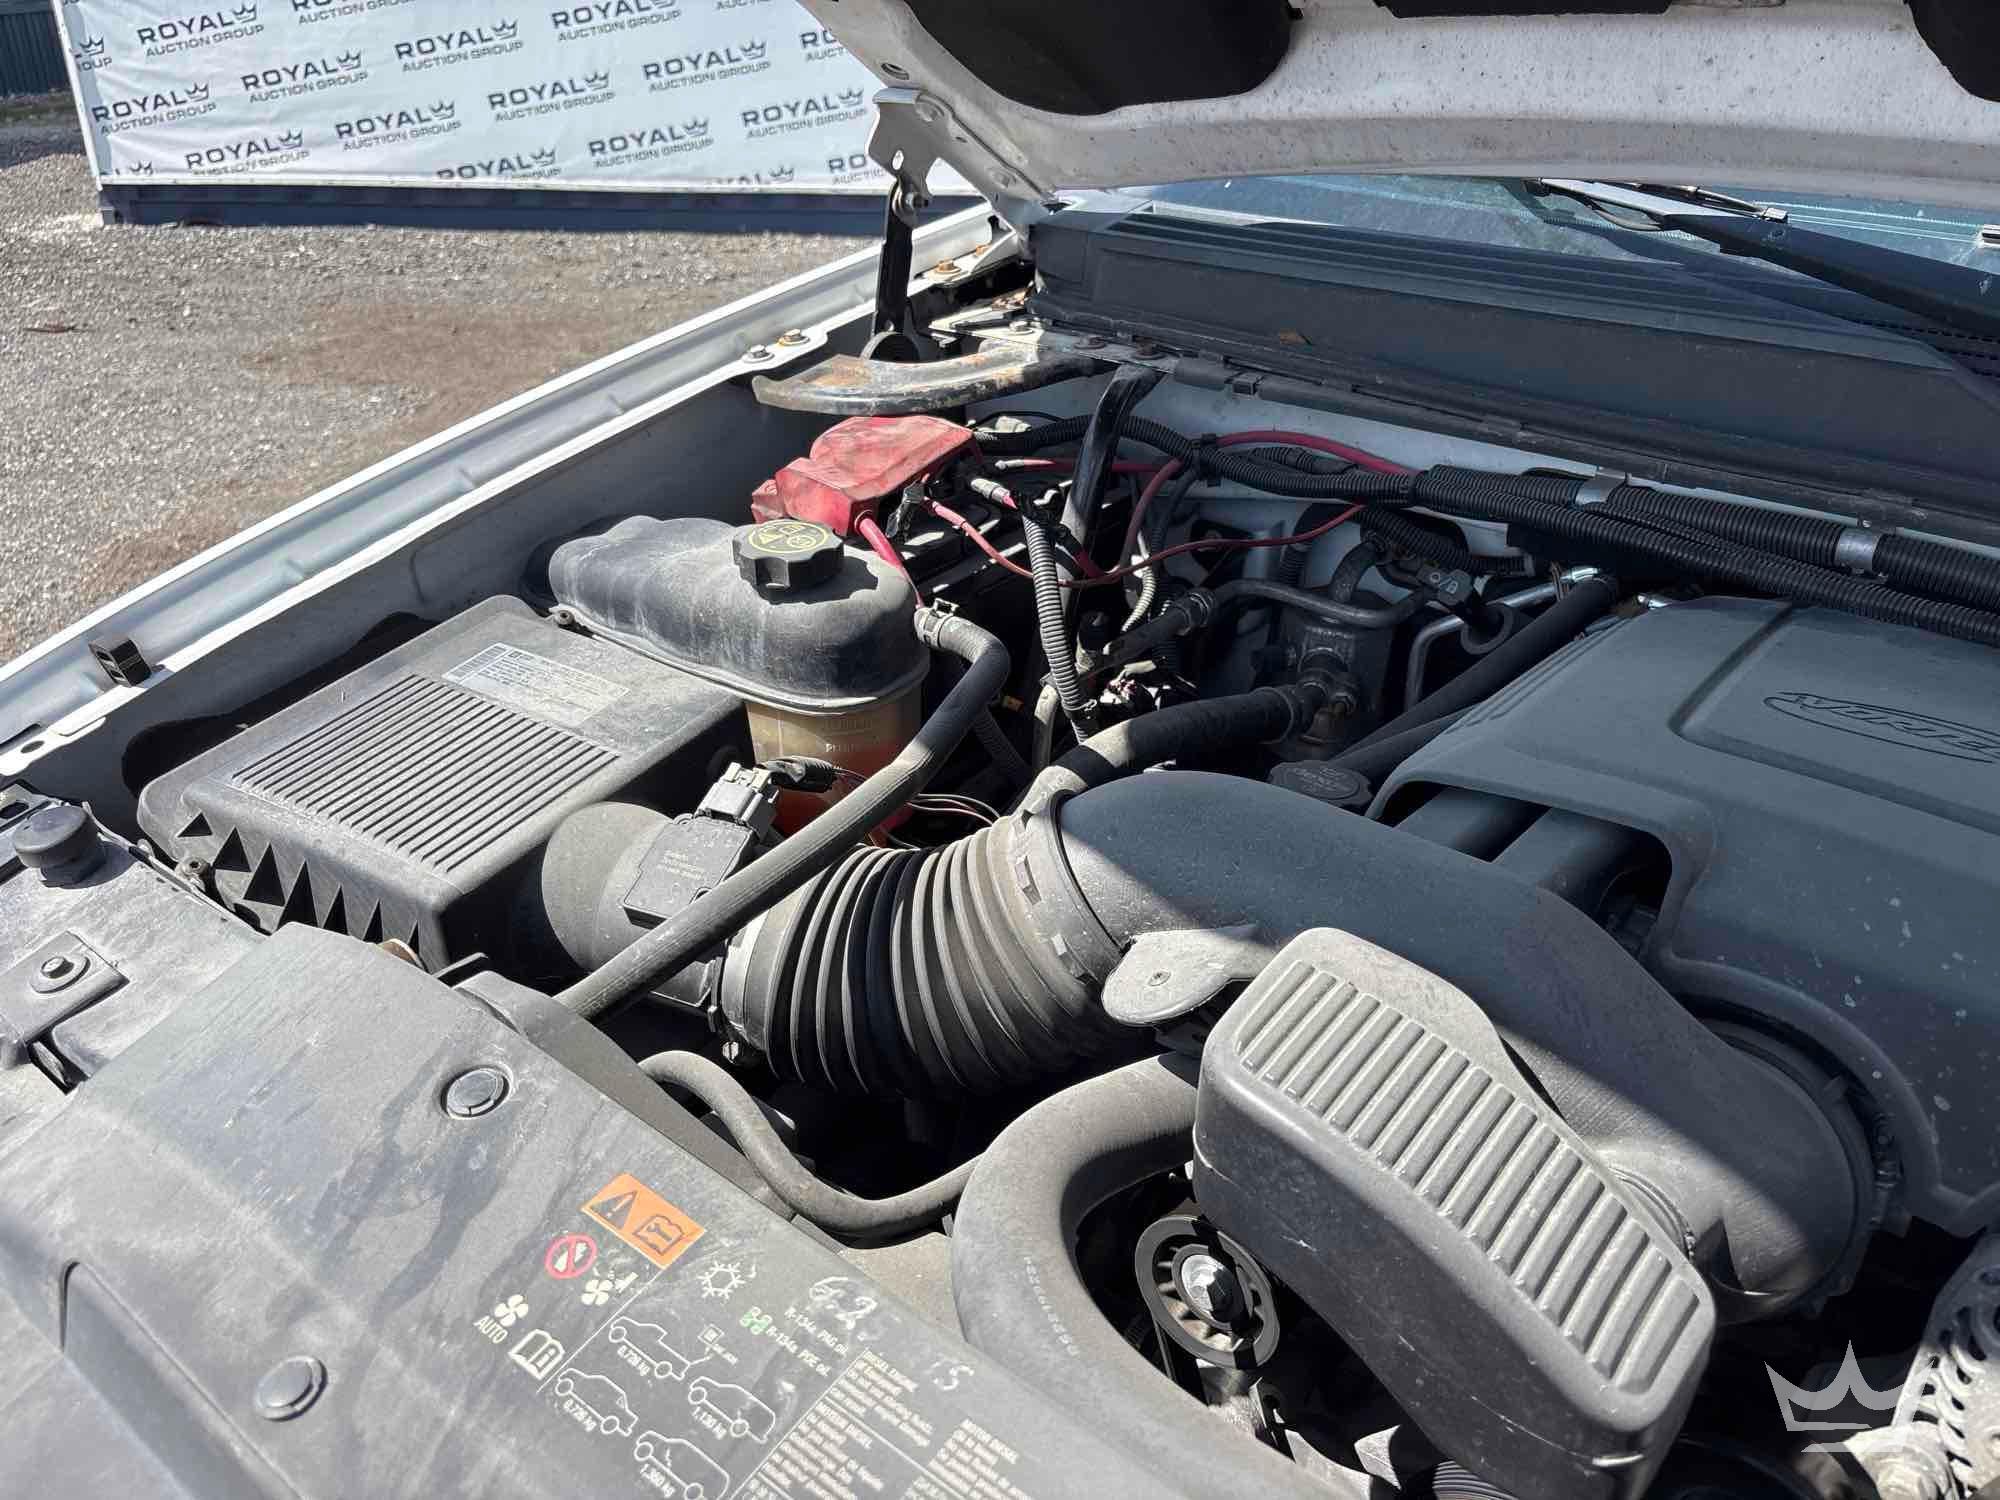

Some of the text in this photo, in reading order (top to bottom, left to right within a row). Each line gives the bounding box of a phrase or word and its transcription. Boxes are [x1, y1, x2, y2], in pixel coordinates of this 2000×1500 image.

[137, 12, 234, 45] ROYAL
[298, 4, 365, 24] AUCTION
[552, 0, 650, 29] ROYAL
[558, 10, 681, 41] AUCTION GROUP
[146, 24, 264, 57] AUCTION GROUP
[395, 27, 493, 59] ROYAL
[402, 41, 524, 72] AUCTION GROUP
[643, 48, 742, 80] ROYAL
[241, 59, 338, 91] ROYAL
[250, 72, 368, 103] AUCTION GROUP
[649, 61, 771, 92] AUCTION GROUP
[92, 91, 186, 122] ROYAL
[487, 79, 585, 110] ROYAL
[495, 91, 616, 122] AUCTION GROUP
[100, 102, 217, 136] AUCTION GROUP
[335, 107, 431, 139] ROYAL
[741, 96, 840, 127] ROYAL
[343, 120, 462, 152] AUCTION GROUP
[589, 126, 684, 157] ROYAL
[747, 117, 813, 139] AUCTION
[185, 138, 280, 169] ROYAL
[436, 154, 533, 179] ROYAL
[594, 149, 659, 168] AUCTION
[473, 1315, 508, 1344] AUTO
